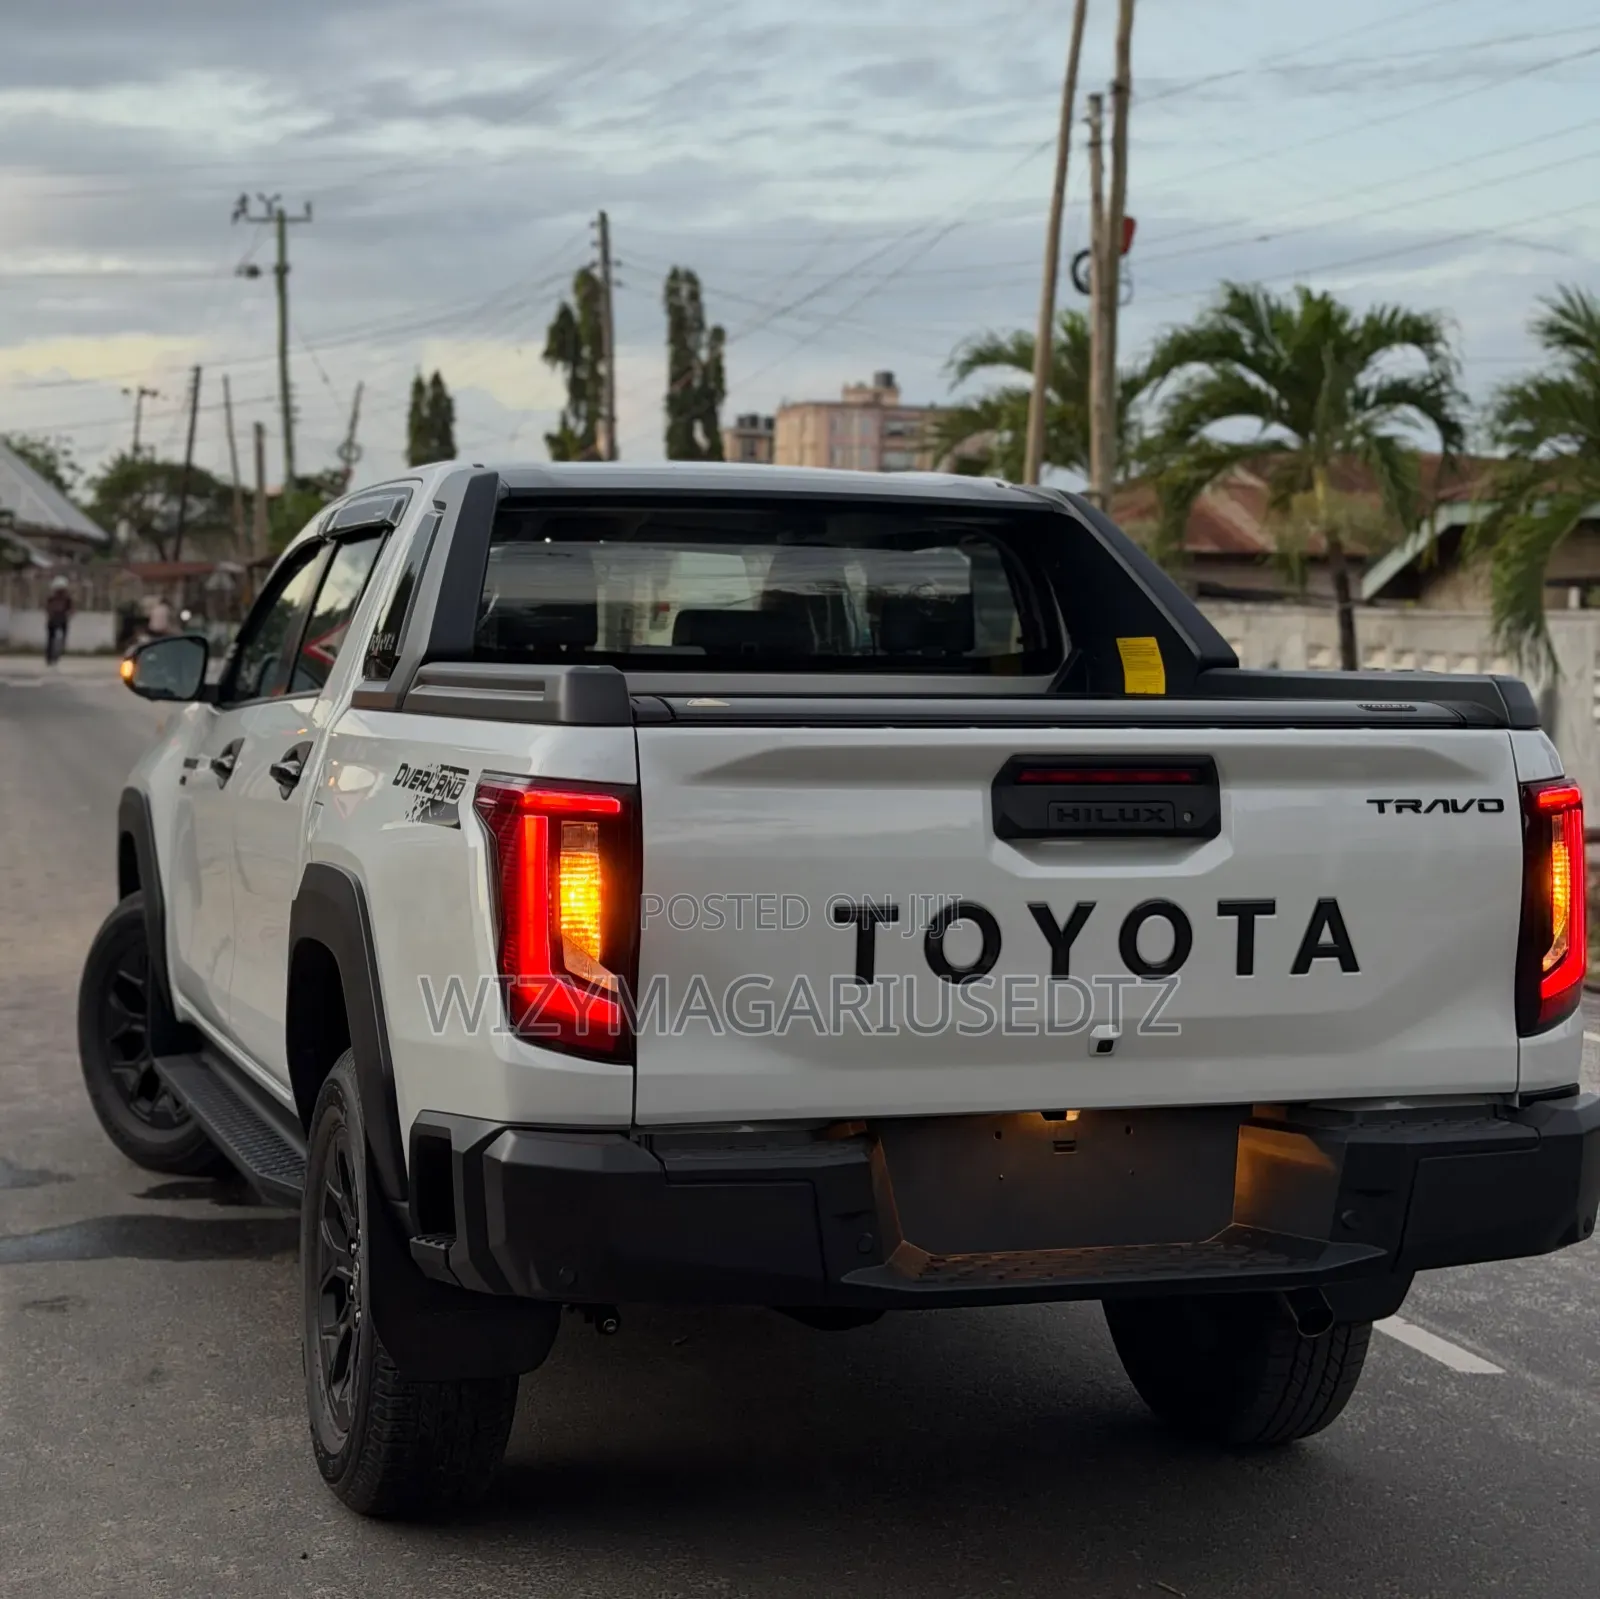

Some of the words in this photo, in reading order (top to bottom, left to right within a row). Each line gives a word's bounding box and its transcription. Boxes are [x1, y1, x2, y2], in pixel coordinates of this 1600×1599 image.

[392, 763, 467, 800] OVERLAND
[1056, 807, 1167, 823] HILUX
[1366, 799, 1505, 814] TRAVO
[833, 898, 1362, 985] TOYOTA
